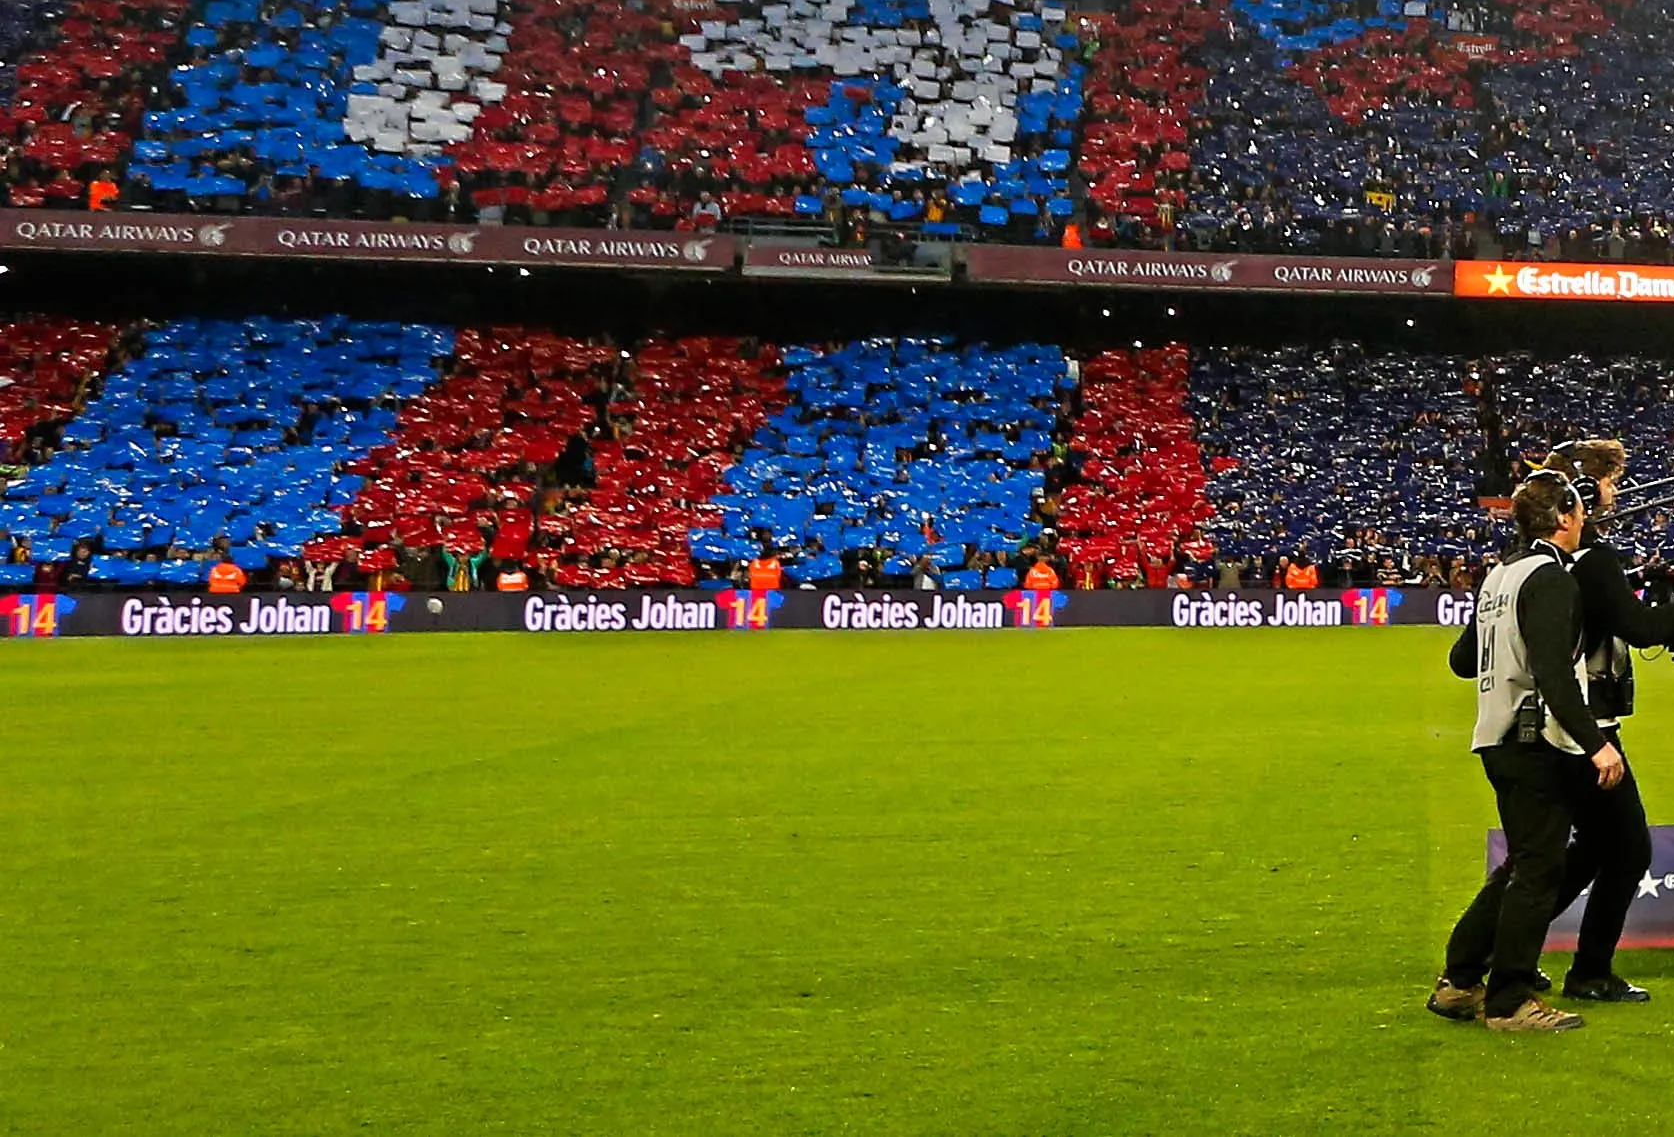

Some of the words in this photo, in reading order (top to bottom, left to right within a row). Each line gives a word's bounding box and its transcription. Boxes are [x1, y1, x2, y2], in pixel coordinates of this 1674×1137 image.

[17, 221, 93, 240] QATAR
[98, 224, 194, 243] AIRWAYS
[278, 229, 354, 248] QATAR
[358, 232, 444, 251] AIRWAYS
[523, 237, 589, 256] QATAR
[599, 240, 680, 259] AIRWAYS
[779, 252, 824, 264] QATAR
[828, 253, 873, 266] AIRWA
[1067, 259, 1128, 277] QATAR
[1133, 261, 1208, 280] AIRWAYS
[1274, 265, 1334, 282] QATAR
[1338, 266, 1408, 285] AIRWAYS
[1517, 266, 1614, 297] Estrella
[14, 601, 58, 635] 14
[121, 595, 233, 635] Gràcies
[240, 597, 330, 634] Johan
[346, 599, 388, 632] 14
[525, 594, 627, 632] Gràcies
[631, 594, 716, 631] Johan
[729, 597, 768, 629] 14
[822, 592, 919, 629] Gràcies
[924, 592, 1003, 628] Johan
[1016, 597, 1053, 626] 14
[1172, 592, 1263, 627] Gràcies
[1267, 593, 1342, 627] Johan
[1355, 596, 1388, 625] 14
